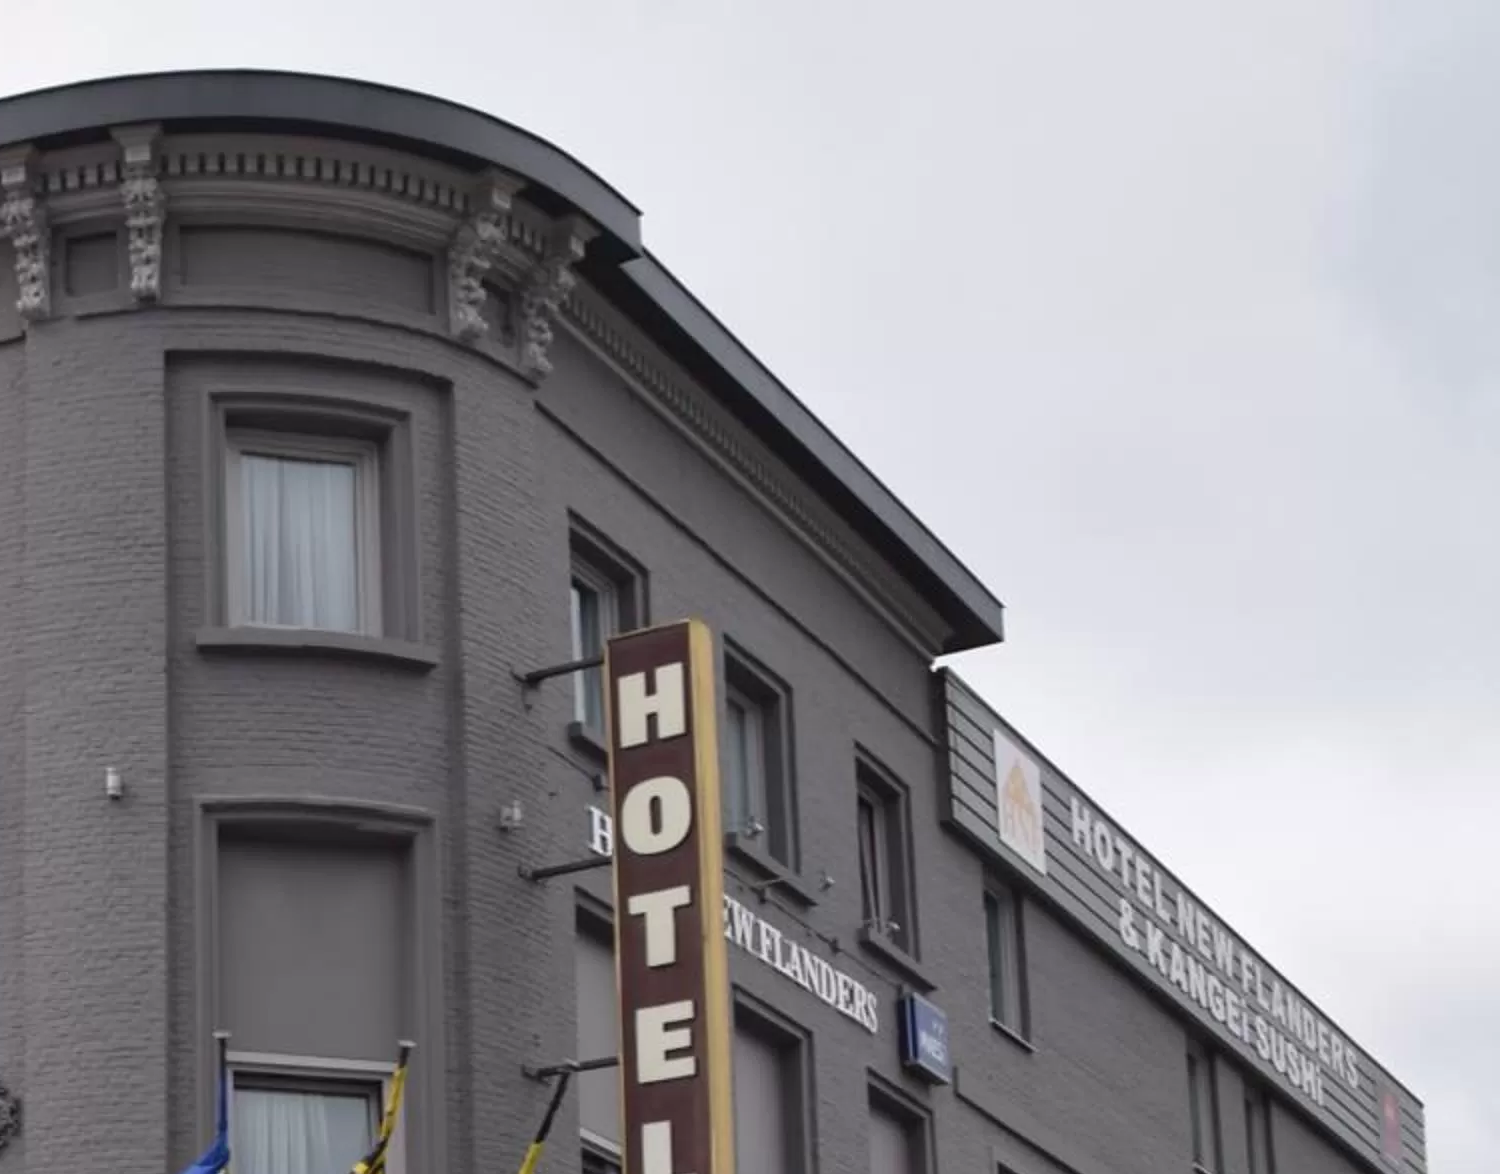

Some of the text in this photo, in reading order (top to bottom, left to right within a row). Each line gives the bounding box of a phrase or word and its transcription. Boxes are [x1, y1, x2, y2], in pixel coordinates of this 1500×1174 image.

[757, 918, 878, 1035] FLANDERS
[1070, 796, 1172, 924] HOTEL
[1176, 891, 1234, 979] NEW
[1240, 950, 1359, 1089] FLANDERS
[1120, 898, 1142, 950] &
